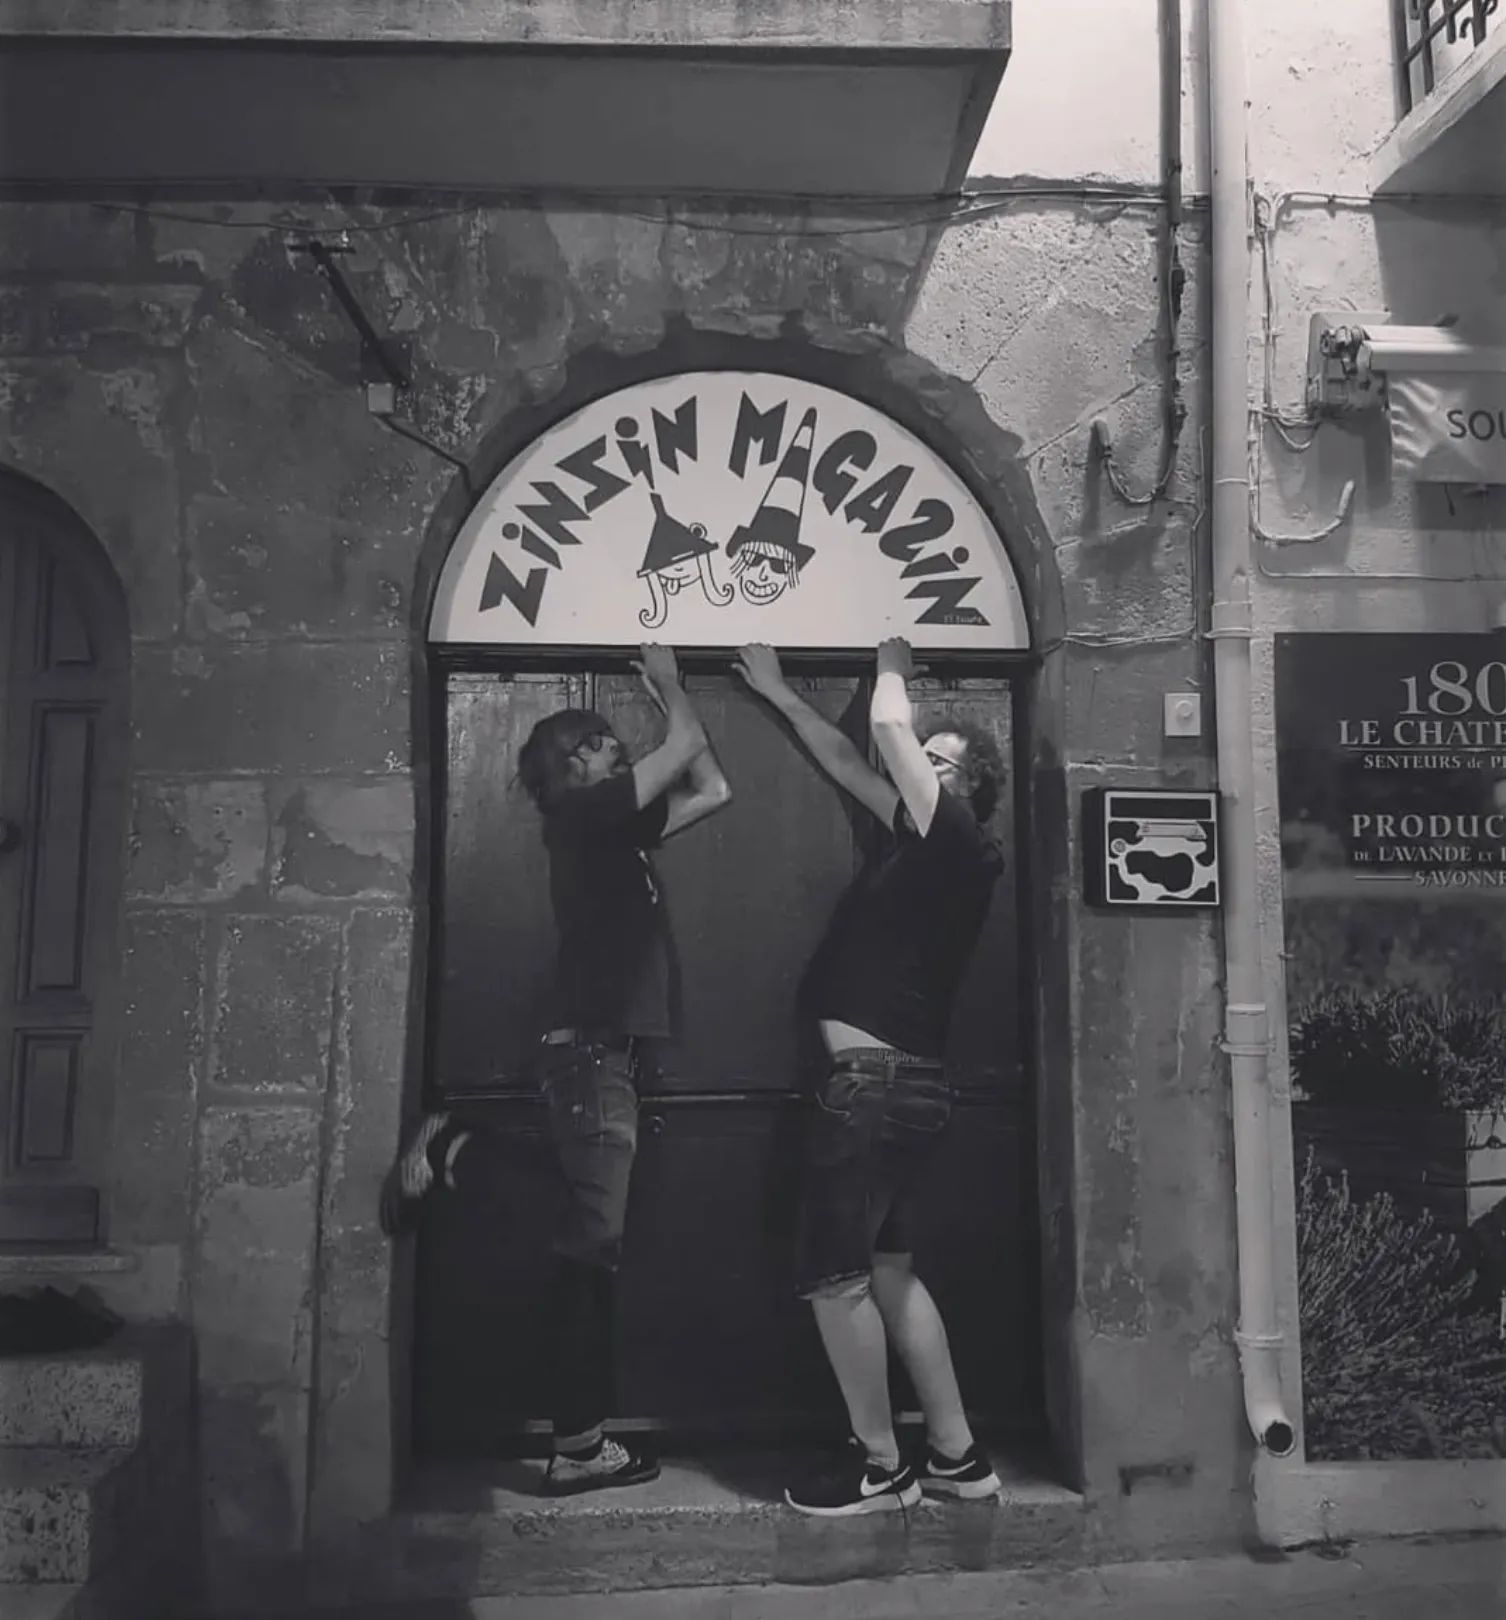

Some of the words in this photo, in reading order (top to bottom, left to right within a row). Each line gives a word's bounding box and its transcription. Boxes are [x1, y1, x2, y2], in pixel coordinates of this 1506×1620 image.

[1338, 719, 1382, 746] LE
[1363, 754, 1461, 769] SENTEURS
[1490, 754, 1506, 769] P
[1352, 813, 1504, 838] PRODUC
[1379, 845, 1473, 862] LAVANDE
